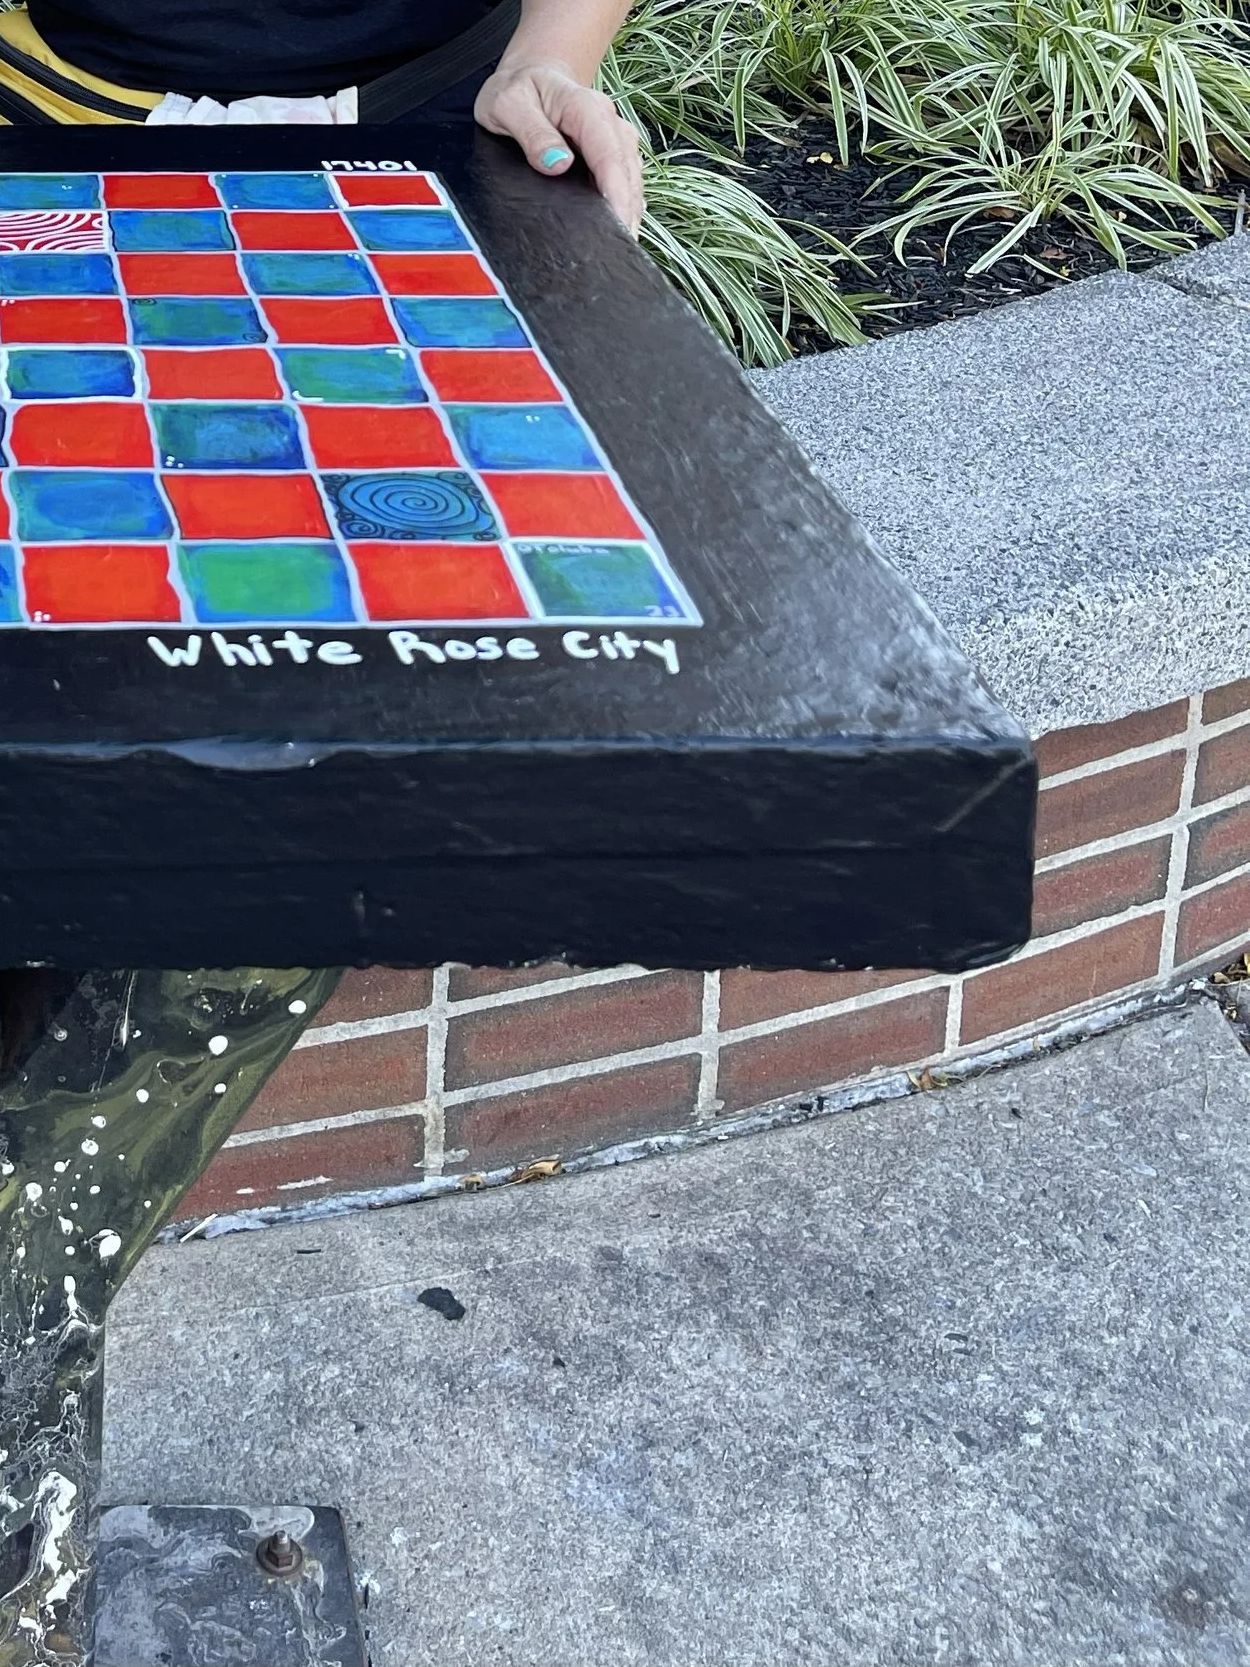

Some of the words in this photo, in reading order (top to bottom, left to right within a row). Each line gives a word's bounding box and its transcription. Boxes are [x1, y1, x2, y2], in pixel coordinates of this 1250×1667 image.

[321, 160, 417, 171] 17401
[147, 631, 363, 667] White
[388, 631, 540, 665] Rose
[562, 630, 680, 674] City
